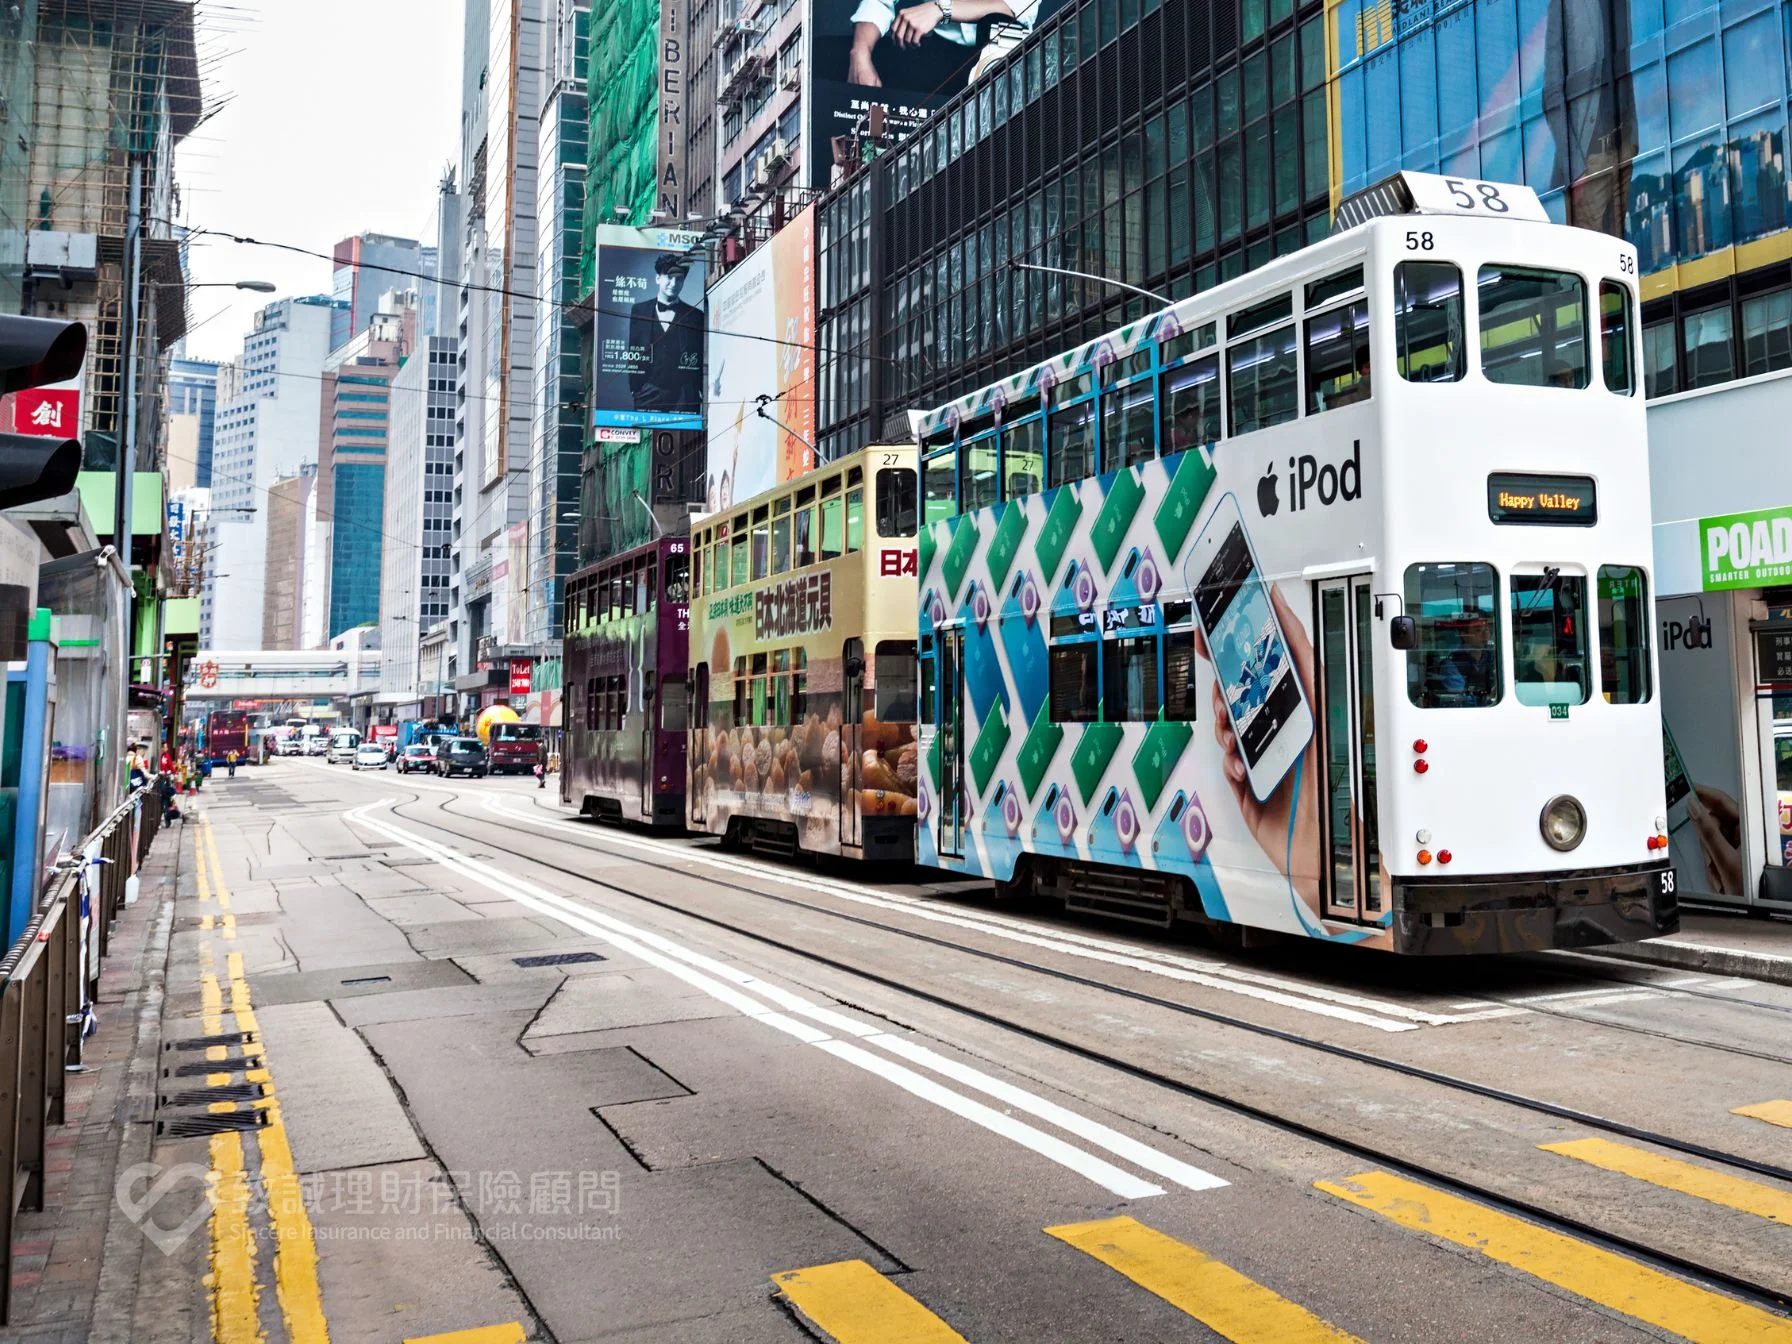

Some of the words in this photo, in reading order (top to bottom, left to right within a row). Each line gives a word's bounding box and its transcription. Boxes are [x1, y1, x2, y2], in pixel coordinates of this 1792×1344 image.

[661, 0, 681, 219] IBERIAN
[1445, 179, 1509, 213] 58
[1405, 231, 1435, 251] 58
[1619, 253, 1634, 275] 58
[882, 454, 900, 466] 27
[1289, 438, 1362, 513] iPod
[1499, 492, 1535, 509] Happy
[1538, 493, 1580, 511] Valley
[670, 543, 685, 554] 65
[1706, 516, 1792, 572] POAD
[1709, 570, 1750, 584] SMARTER
[755, 570, 832, 641] 日本北海道元貝
[1551, 705, 1568, 717] 034
[1661, 870, 1675, 894] 58
